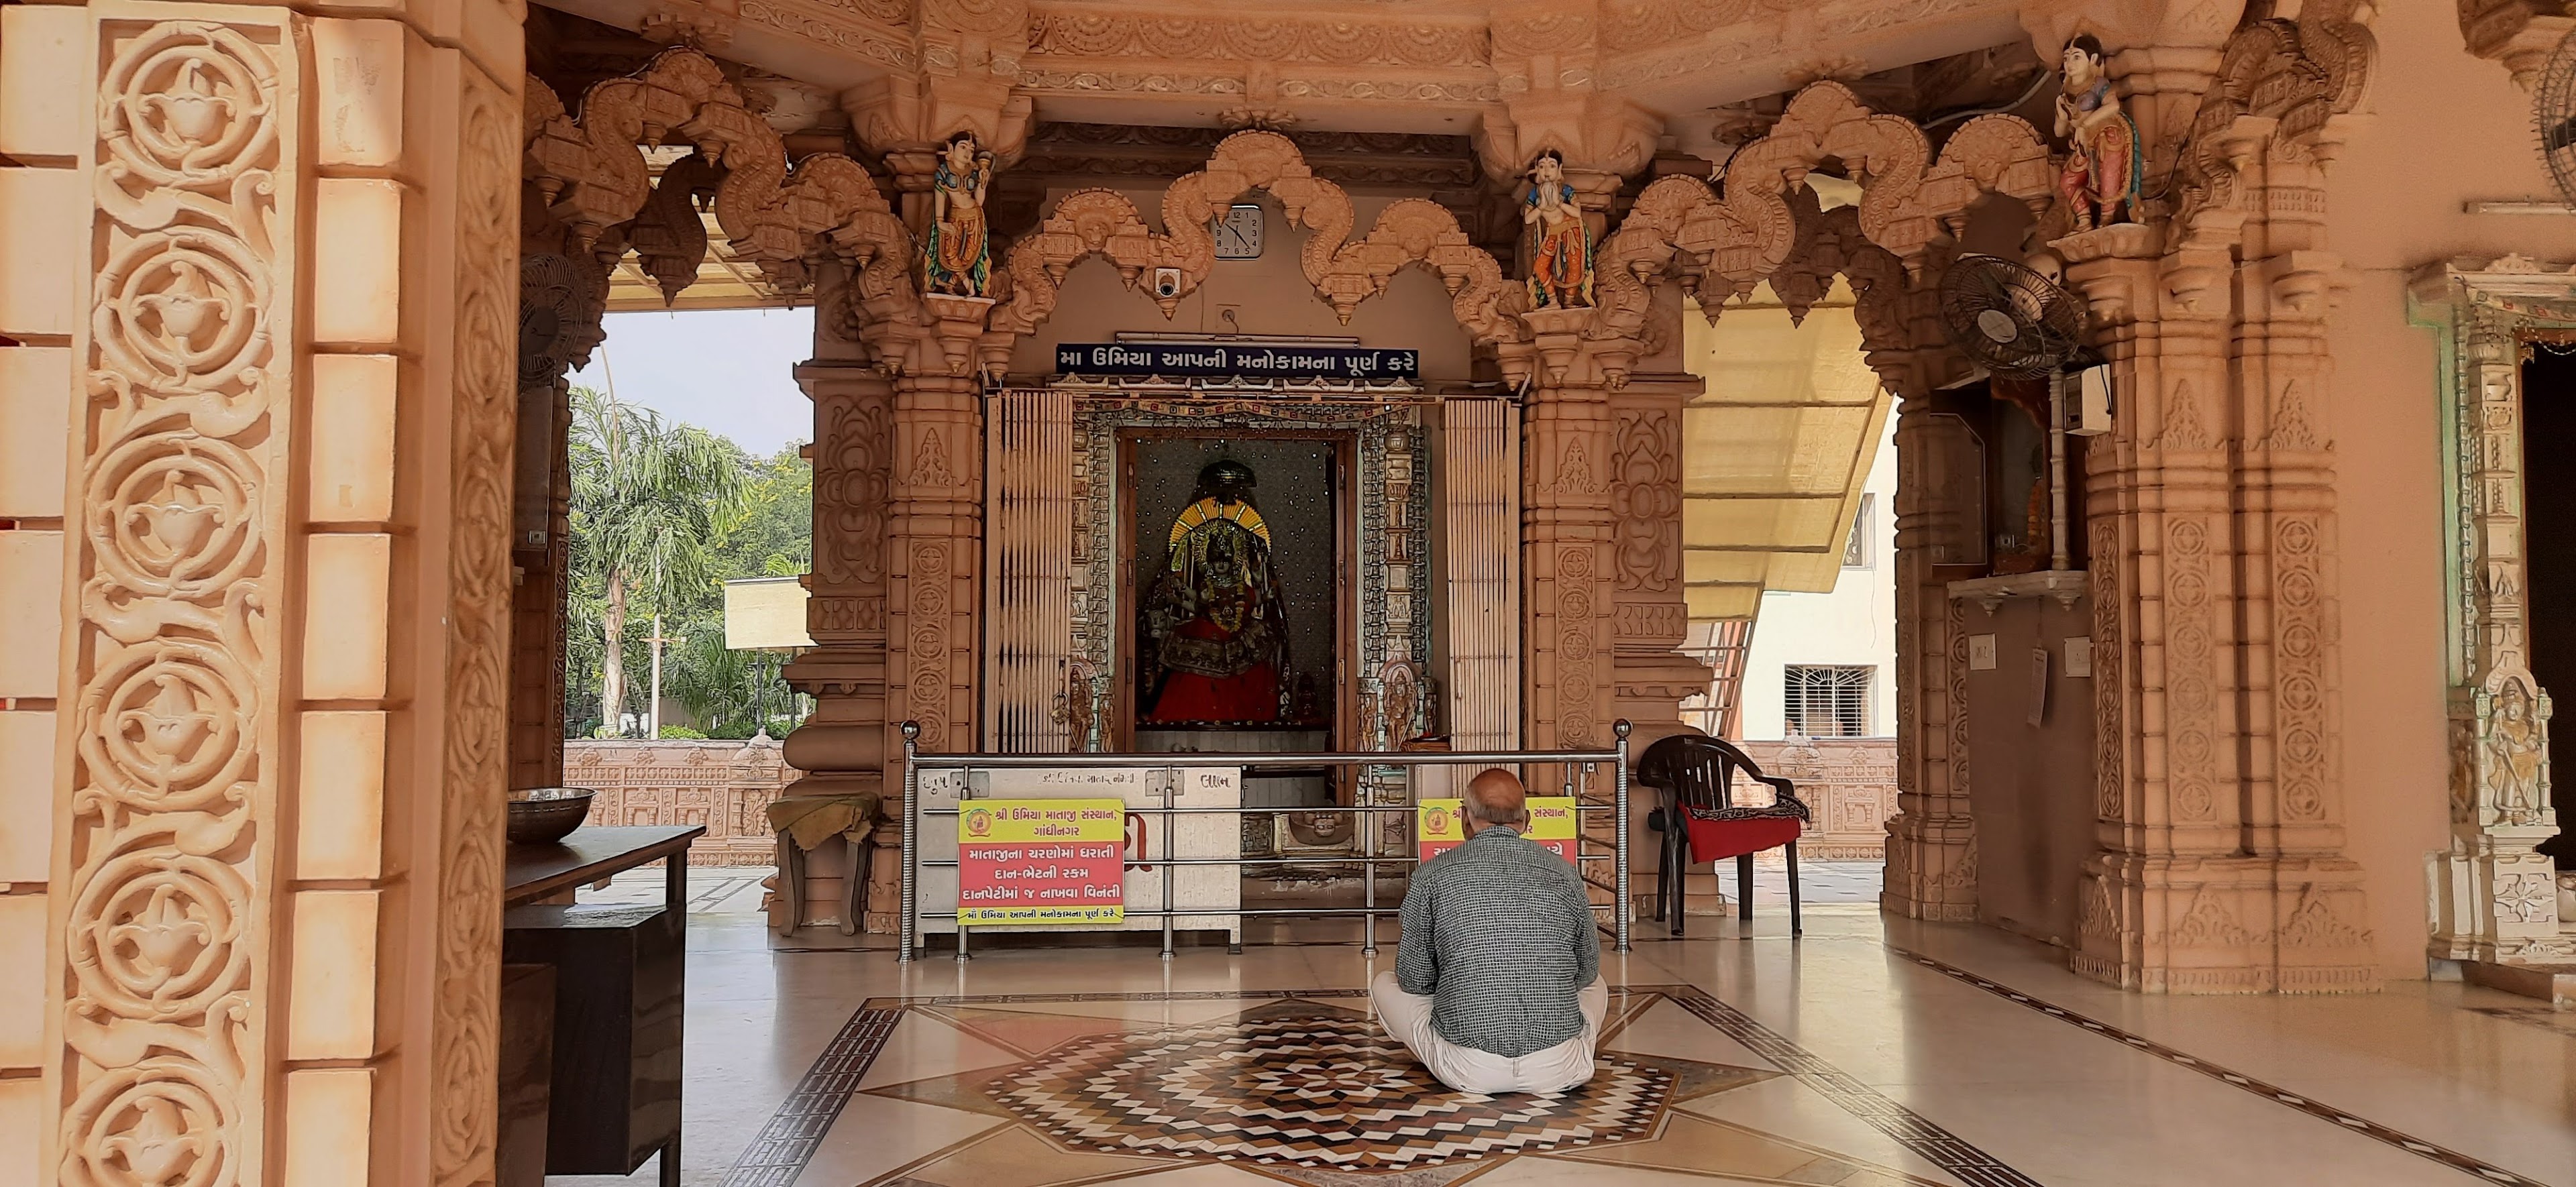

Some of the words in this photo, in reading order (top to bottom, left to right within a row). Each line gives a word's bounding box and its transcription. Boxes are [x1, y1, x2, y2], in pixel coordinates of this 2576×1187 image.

[1061, 352, 1081, 365] મા
[1093, 347, 1151, 365] ઉમિયા
[1162, 349, 1226, 368] આપની
[1236, 349, 1335, 370] મનોકામના
[1344, 351, 1380, 376] પૂર્ણ
[1387, 352, 1415, 371] કરે
[995, 807, 1007, 820] શ્રી
[1013, 807, 1040, 819] ઉમિયા
[1046, 809, 1076, 822] માતાજી
[1034, 824, 1079, 836] ગાંધીનગર
[969, 849, 1022, 862] માતાજીના
[1028, 845, 1073, 859] ચરણોમાં
[1080, 844, 1114, 858] ધરાતી
[995, 865, 1057, 879] દાન-ભેટની
[1063, 868, 1088, 878] રકમ
[963, 885, 1018, 900] દાનપેટીમાં
[1024, 889, 1034, 899] જ
[1040, 888, 1077, 898] નાખવા
[1084, 884, 1120, 898] વિનંતી
[981, 910, 1005, 919] ઉમિયા
[1010, 909, 1036, 918] આપની
[1040, 909, 1081, 917] મનોકામના
[1085, 908, 1099, 920] પૂર્ણ
[1104, 908, 1114, 917] કરે
